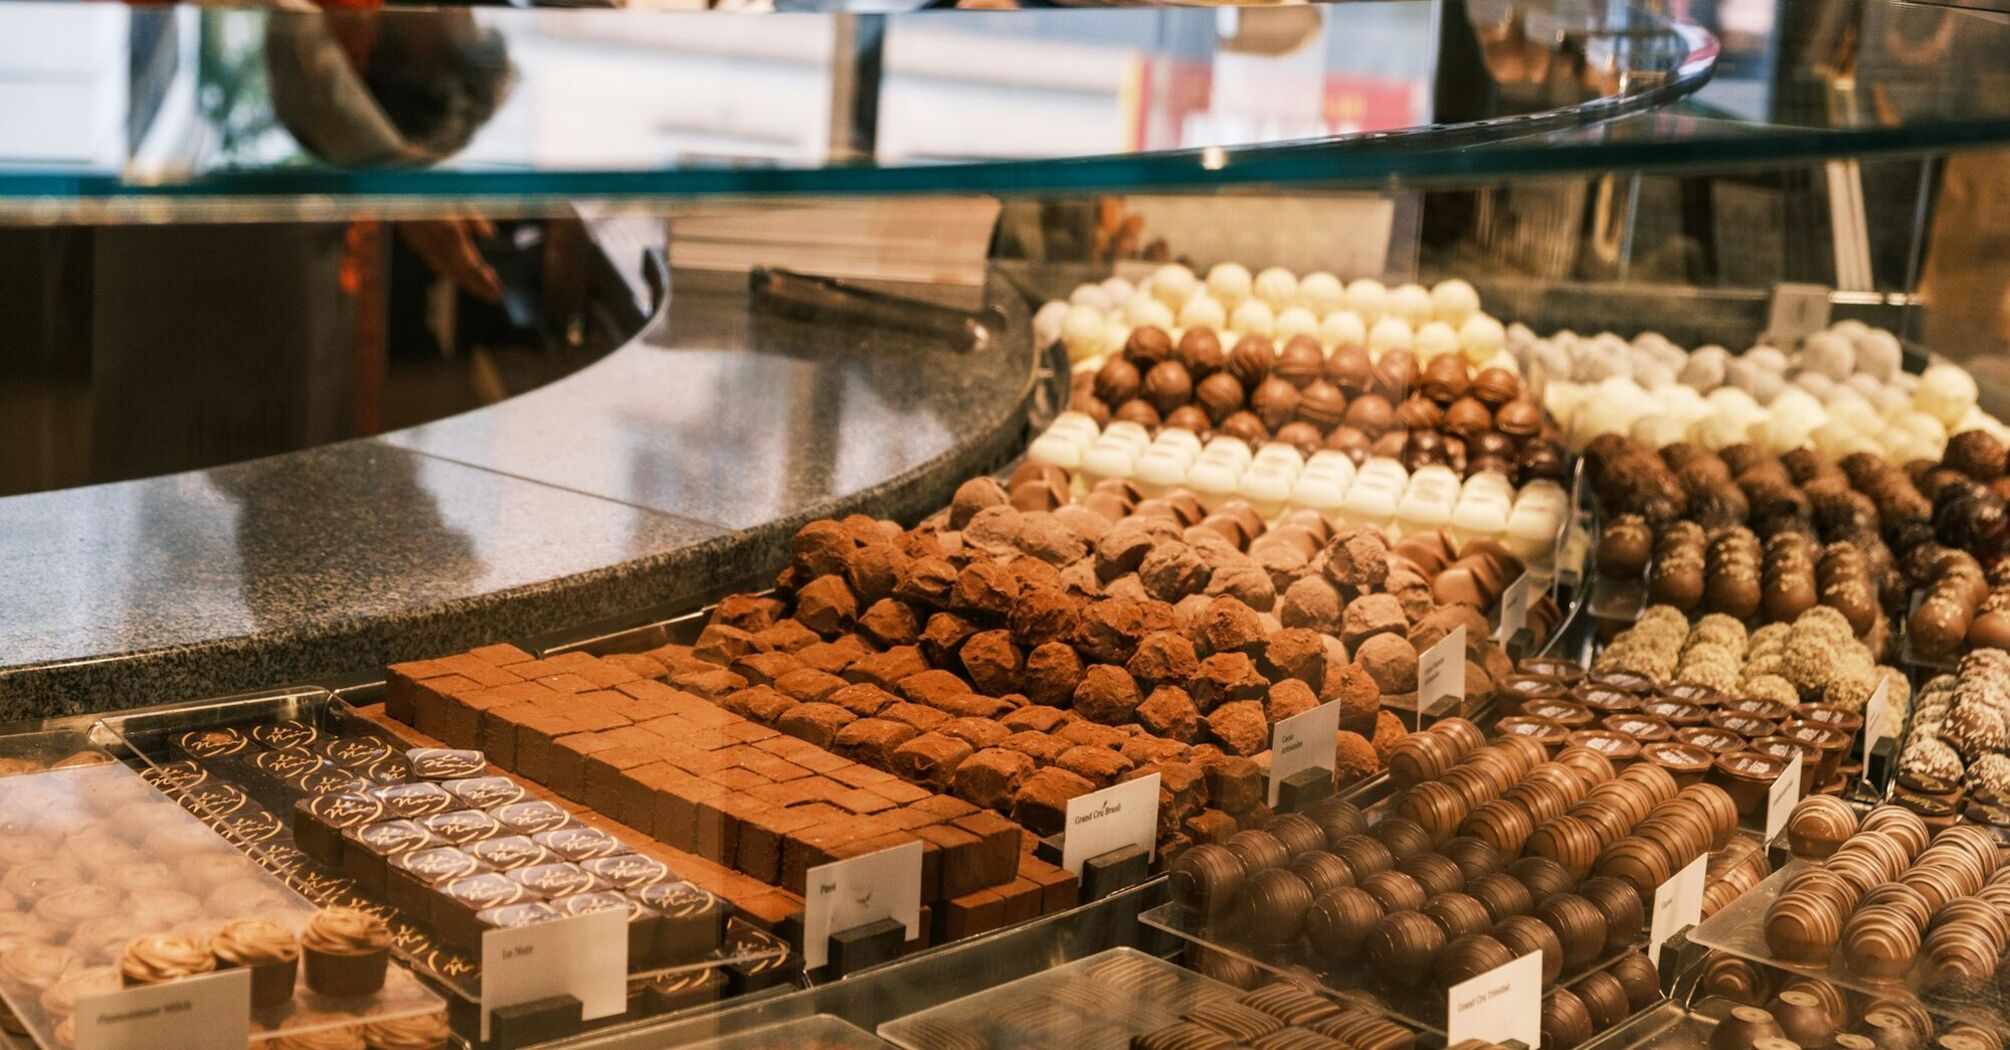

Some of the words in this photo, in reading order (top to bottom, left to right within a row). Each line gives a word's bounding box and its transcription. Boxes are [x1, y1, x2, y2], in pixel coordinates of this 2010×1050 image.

[1075, 812, 1092, 824] Grand
[1093, 810, 1104, 819] Cru
[1457, 998, 1475, 1012] Grand
[1476, 994, 1487, 1004] Cru
